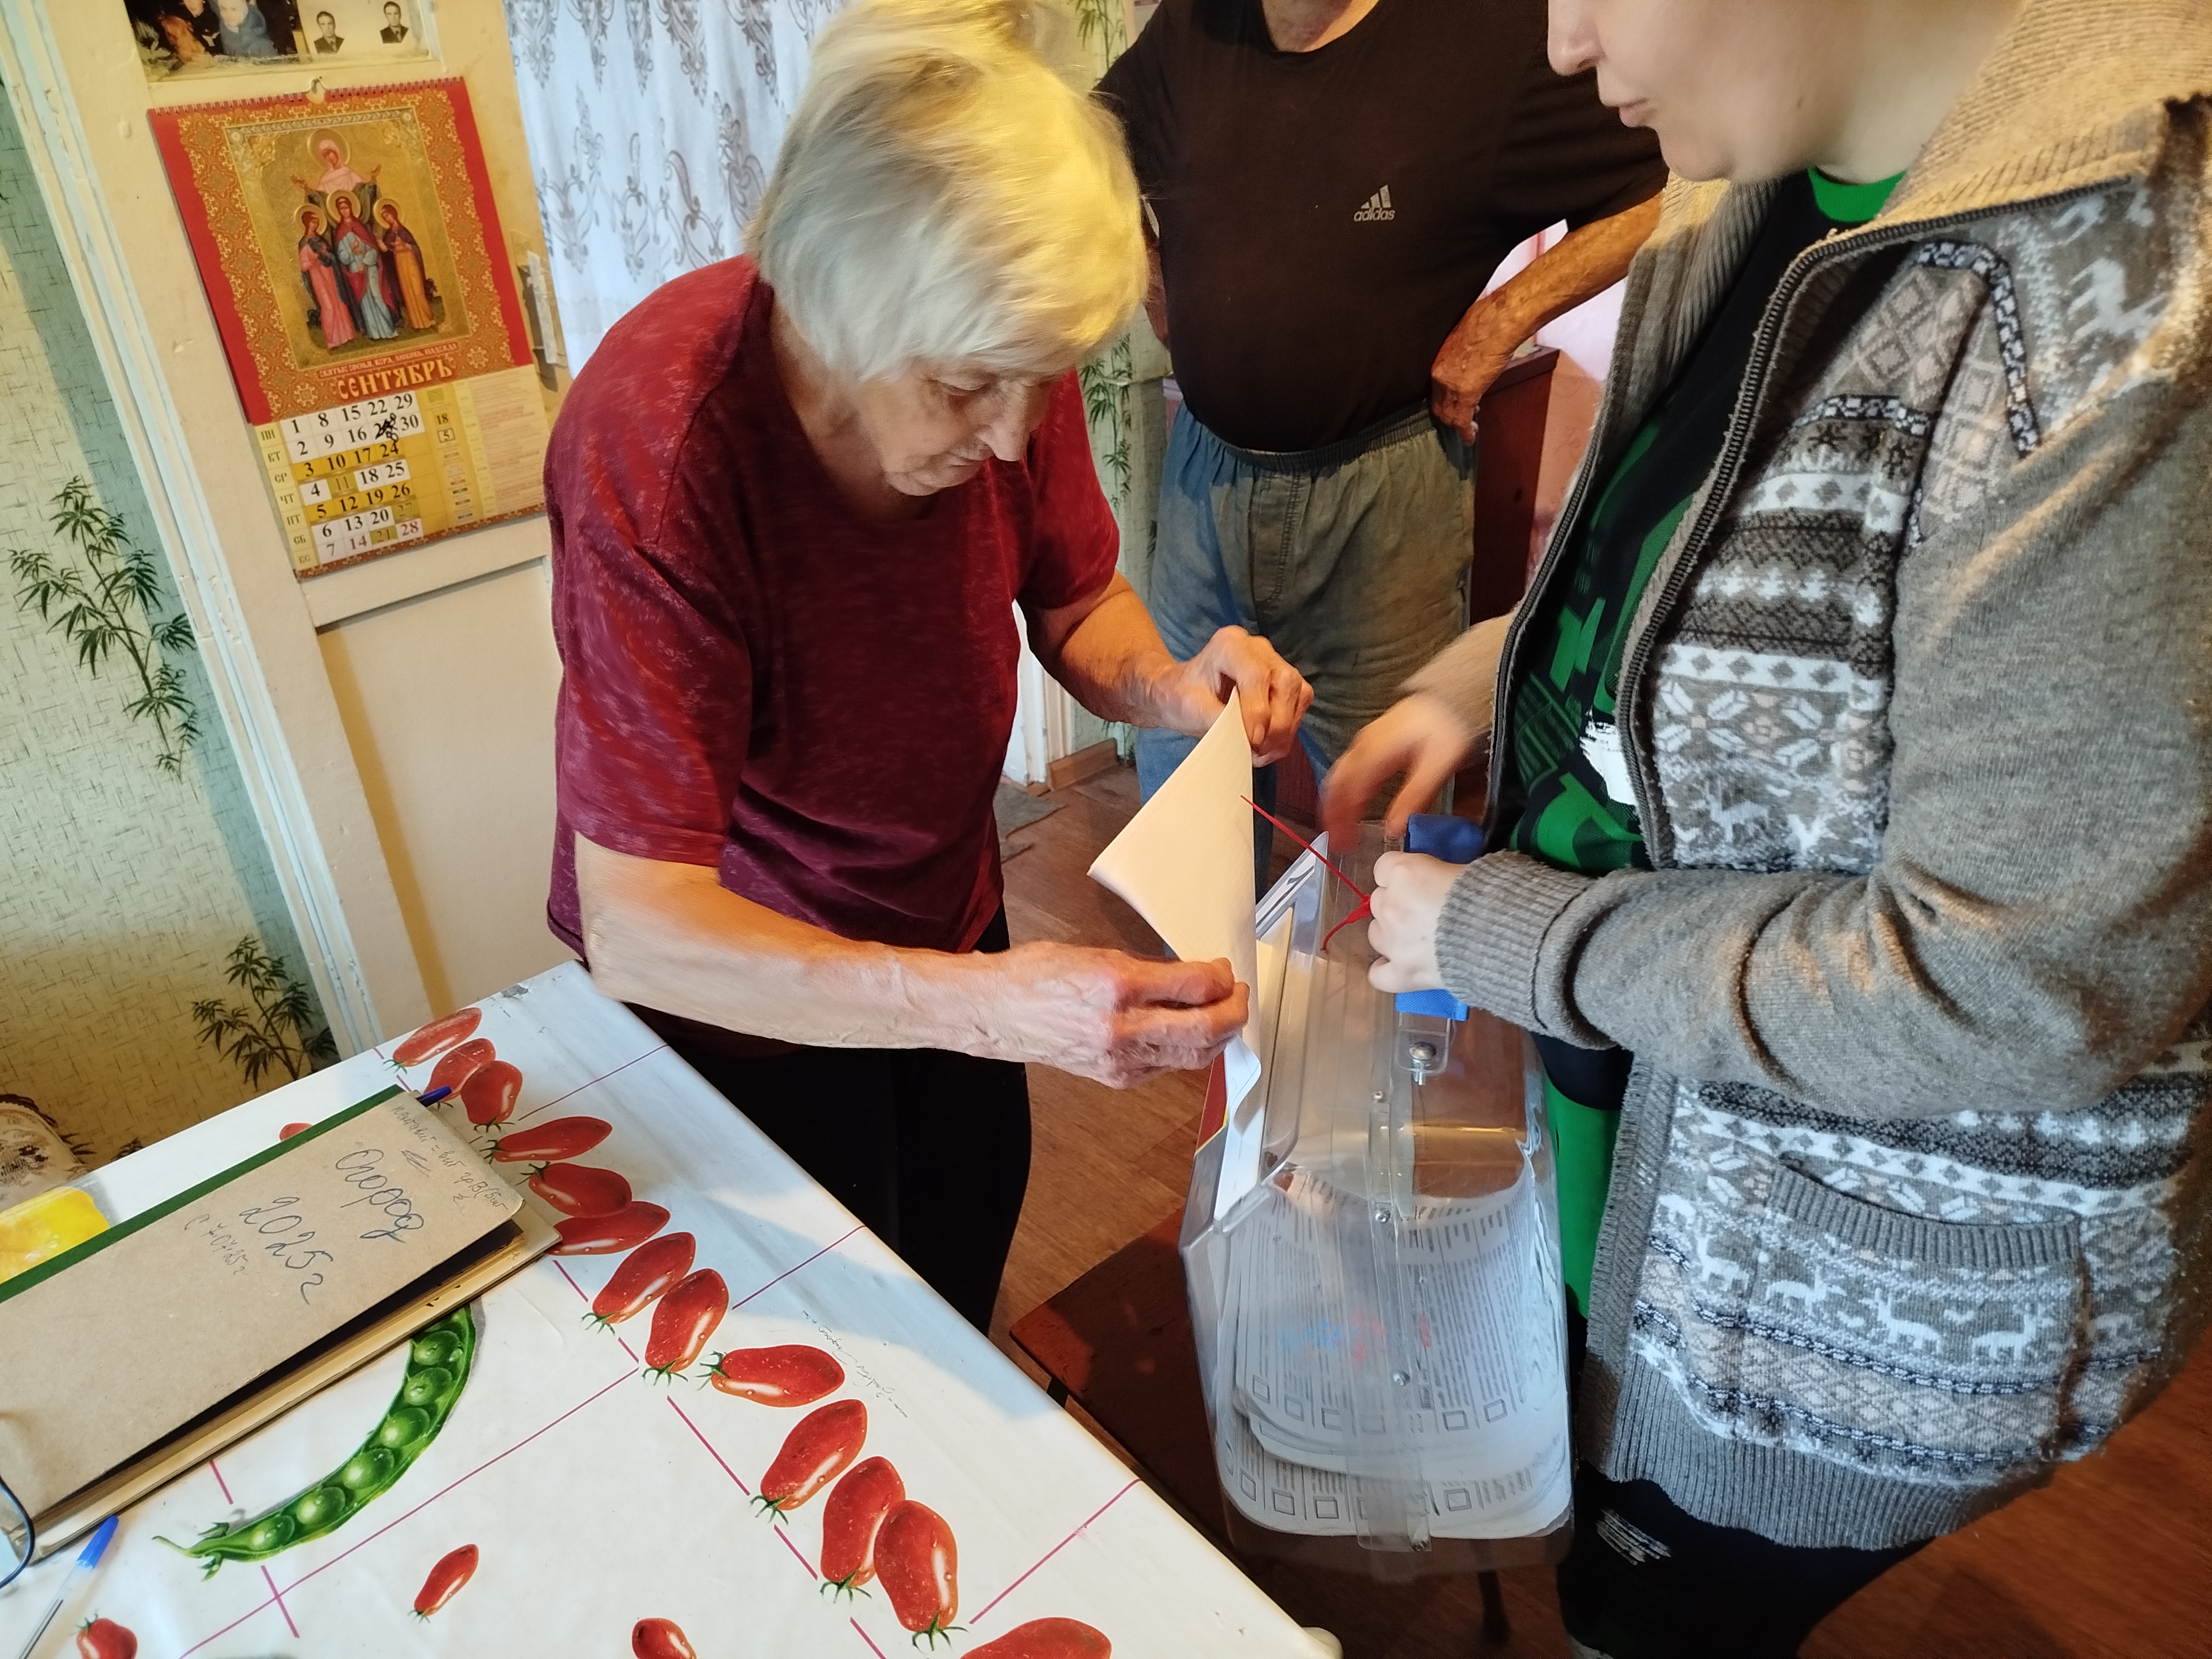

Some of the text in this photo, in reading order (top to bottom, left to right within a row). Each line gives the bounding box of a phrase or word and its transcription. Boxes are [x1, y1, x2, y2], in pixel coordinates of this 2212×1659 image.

[1354, 207, 1395, 221] adidas
[338, 359, 453, 400] СЕНТЯБРЬ
[261, 429, 275, 441] ПН
[291, 419, 300, 435] 1
[317, 412, 329, 427] 8
[341, 404, 361, 422] 15
[367, 399, 388, 416] 22
[394, 393, 413, 410] 29
[297, 441, 309, 456] 2
[324, 434, 334, 450] 9
[347, 429, 367, 444] 16
[400, 414, 419, 431] 30
[436, 413, 449, 425] 18
[274, 442, 399, 483] СР 3 10 17 24
[280, 461, 405, 504] ЧТ 4 11 18 25
[316, 503, 327, 519] 5
[338, 496, 358, 512] 12
[366, 489, 384, 505] 19
[391, 483, 411, 499] 26
[322, 524, 332, 538] 6
[345, 515, 363, 533] 13
[370, 508, 389, 525] 20
[398, 503, 413, 518] 27
[327, 543, 335, 557] 7
[349, 535, 368, 551] 14
[376, 528, 391, 542] 21
[401, 520, 419, 537] 28
